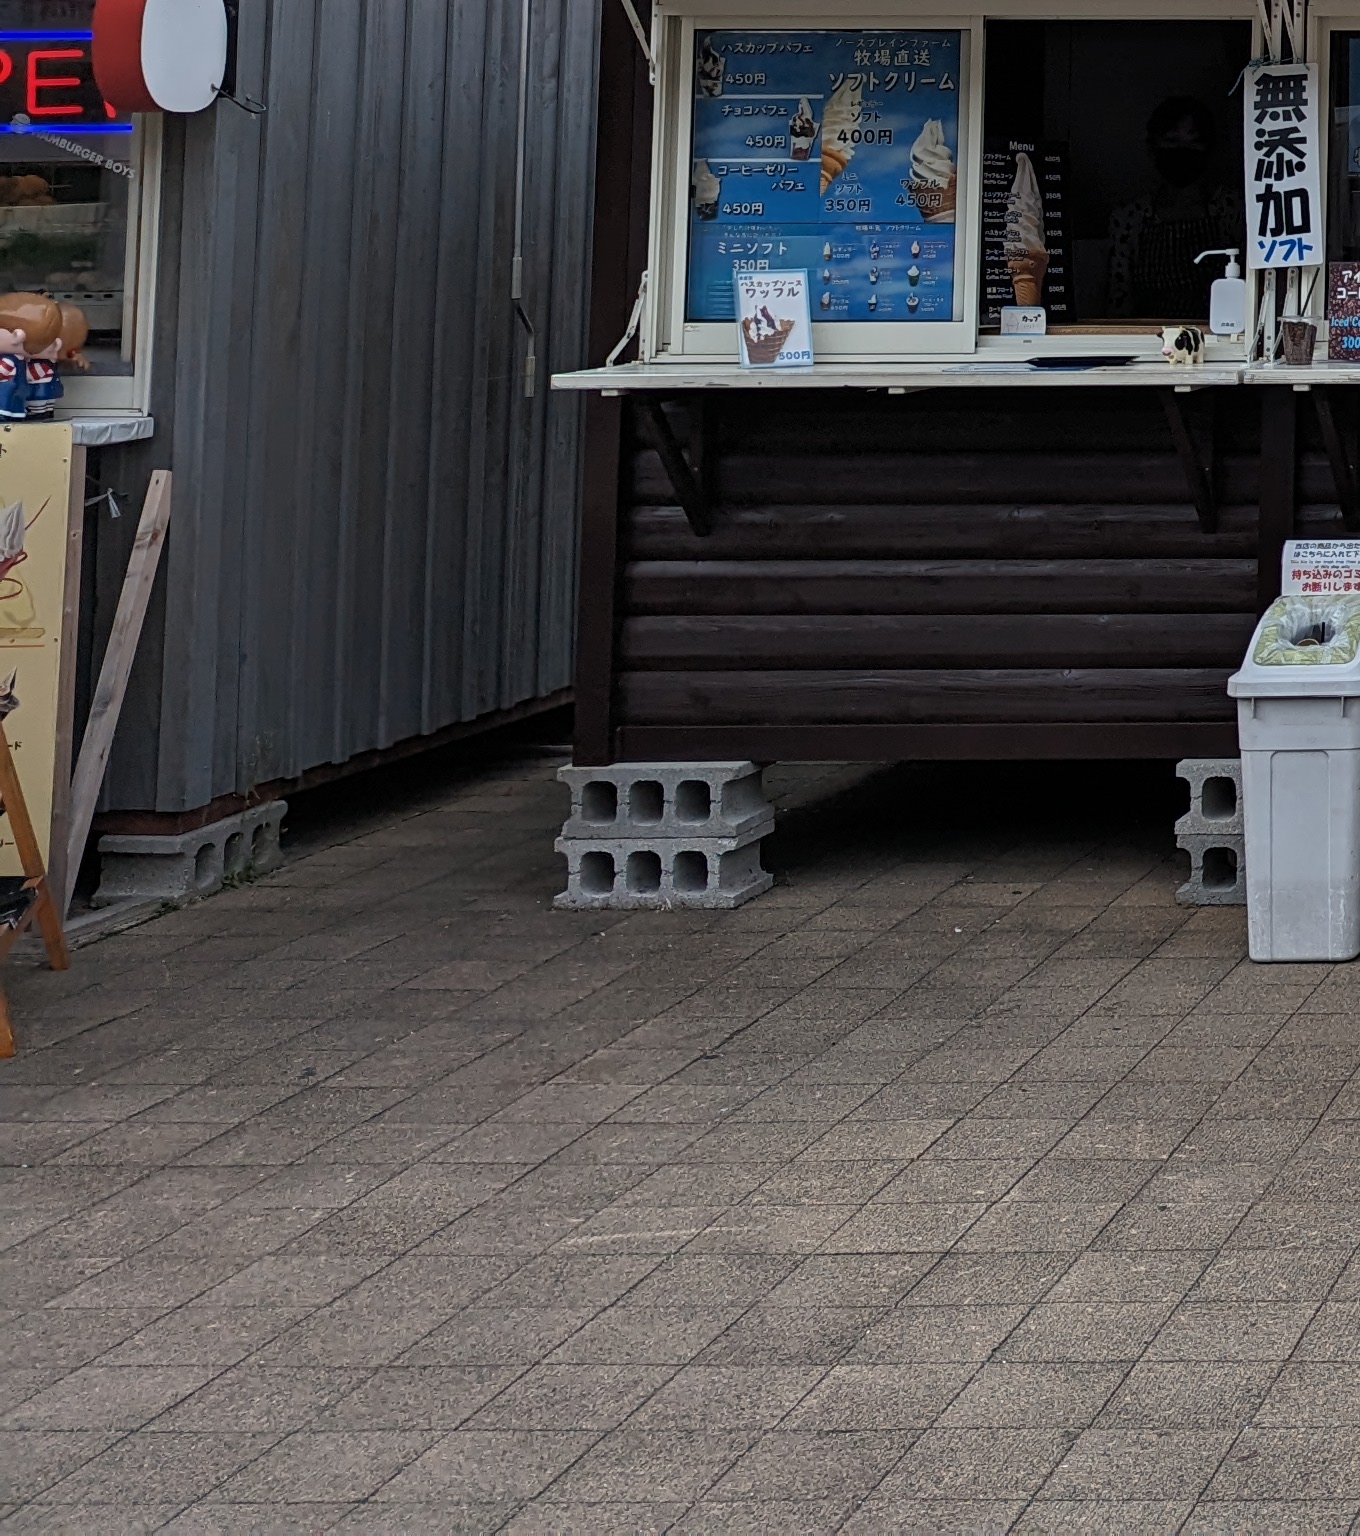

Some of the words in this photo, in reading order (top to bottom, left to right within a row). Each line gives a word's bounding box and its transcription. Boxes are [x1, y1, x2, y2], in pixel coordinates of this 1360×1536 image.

[853, 50, 931, 67] 牧場直送
[829, 71, 956, 93] ソフトクリーム
[837, 128, 893, 146] 400円
[1009, 140, 1035, 151] Menu
[1253, 72, 1312, 238] 無添加
[105, 158, 137, 181] BOYS
[825, 199, 871, 213] 350円
[895, 193, 942, 208] 450円
[722, 202, 764, 215] 450円
[717, 241, 788, 255] ミニソフト
[1258, 237, 1314, 262] ソフト
[745, 287, 799, 299] ワッフル
[1331, 316, 1350, 328] Iced
[778, 350, 811, 361] 500円
